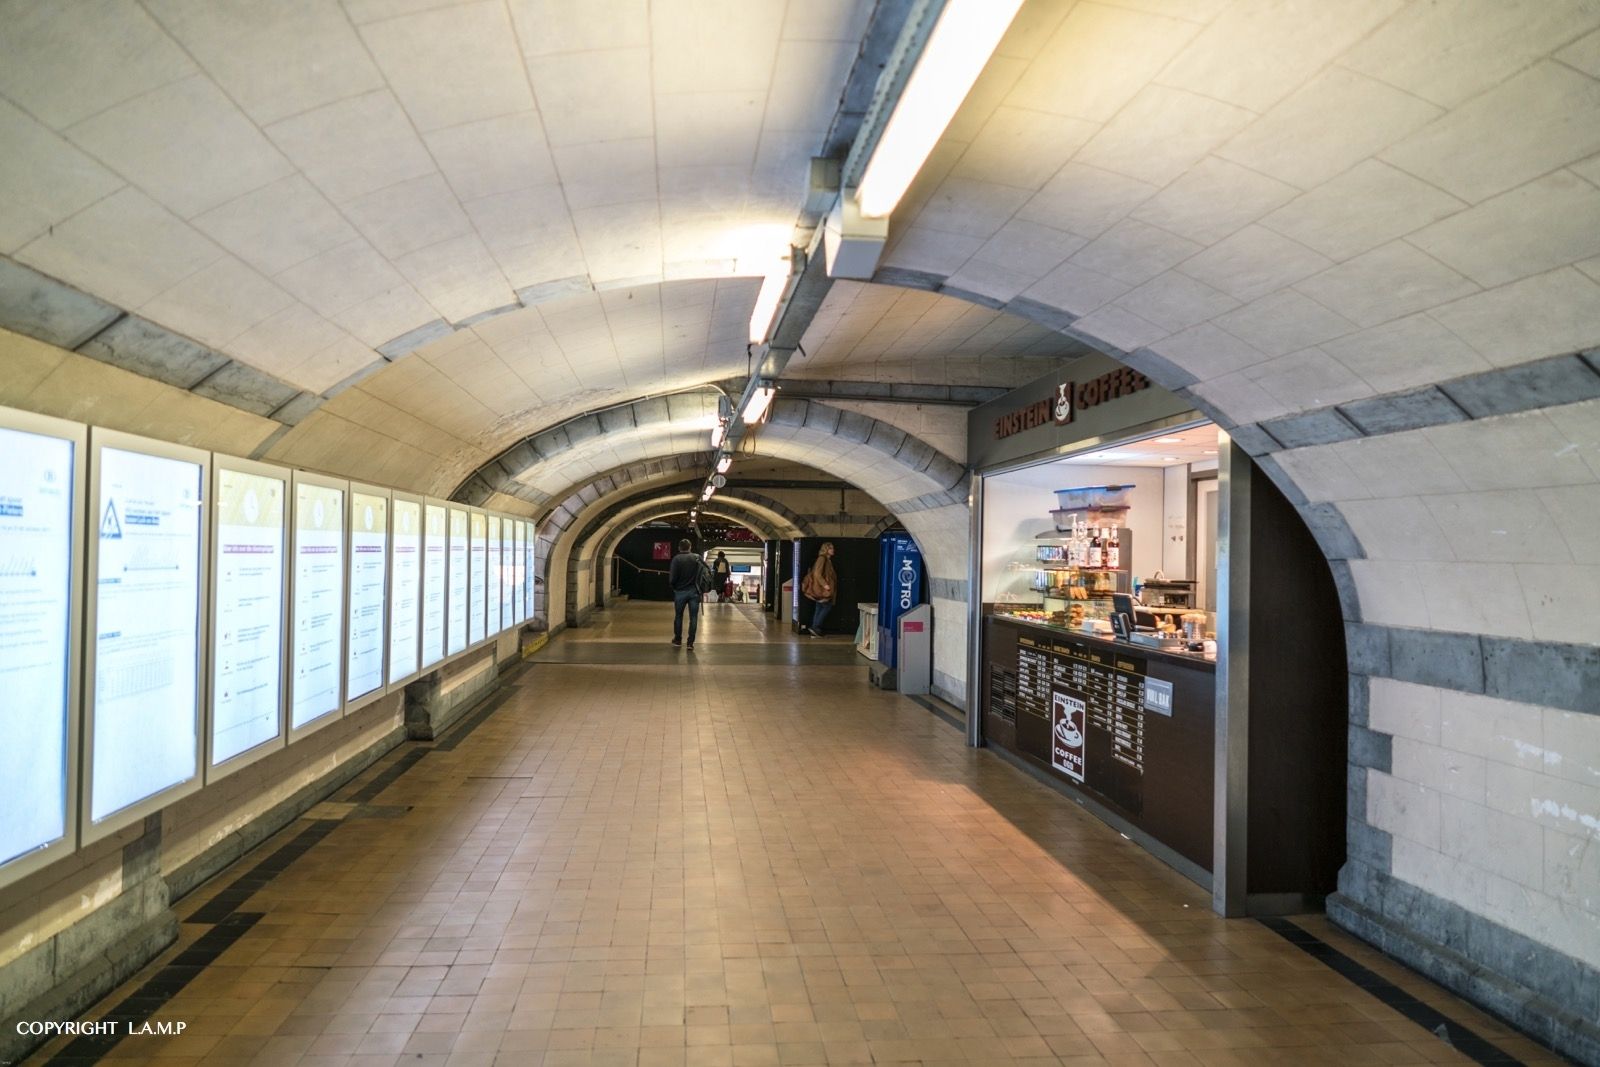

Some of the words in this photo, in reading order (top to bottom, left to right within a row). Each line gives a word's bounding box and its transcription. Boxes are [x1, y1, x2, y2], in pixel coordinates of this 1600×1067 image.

[994, 398, 1053, 440] EINSTEIN
[1076, 366, 1150, 410] COFFEE
[1054, 694, 1084, 711] EINSTEIN
[1055, 747, 1082, 766] COFFEE
